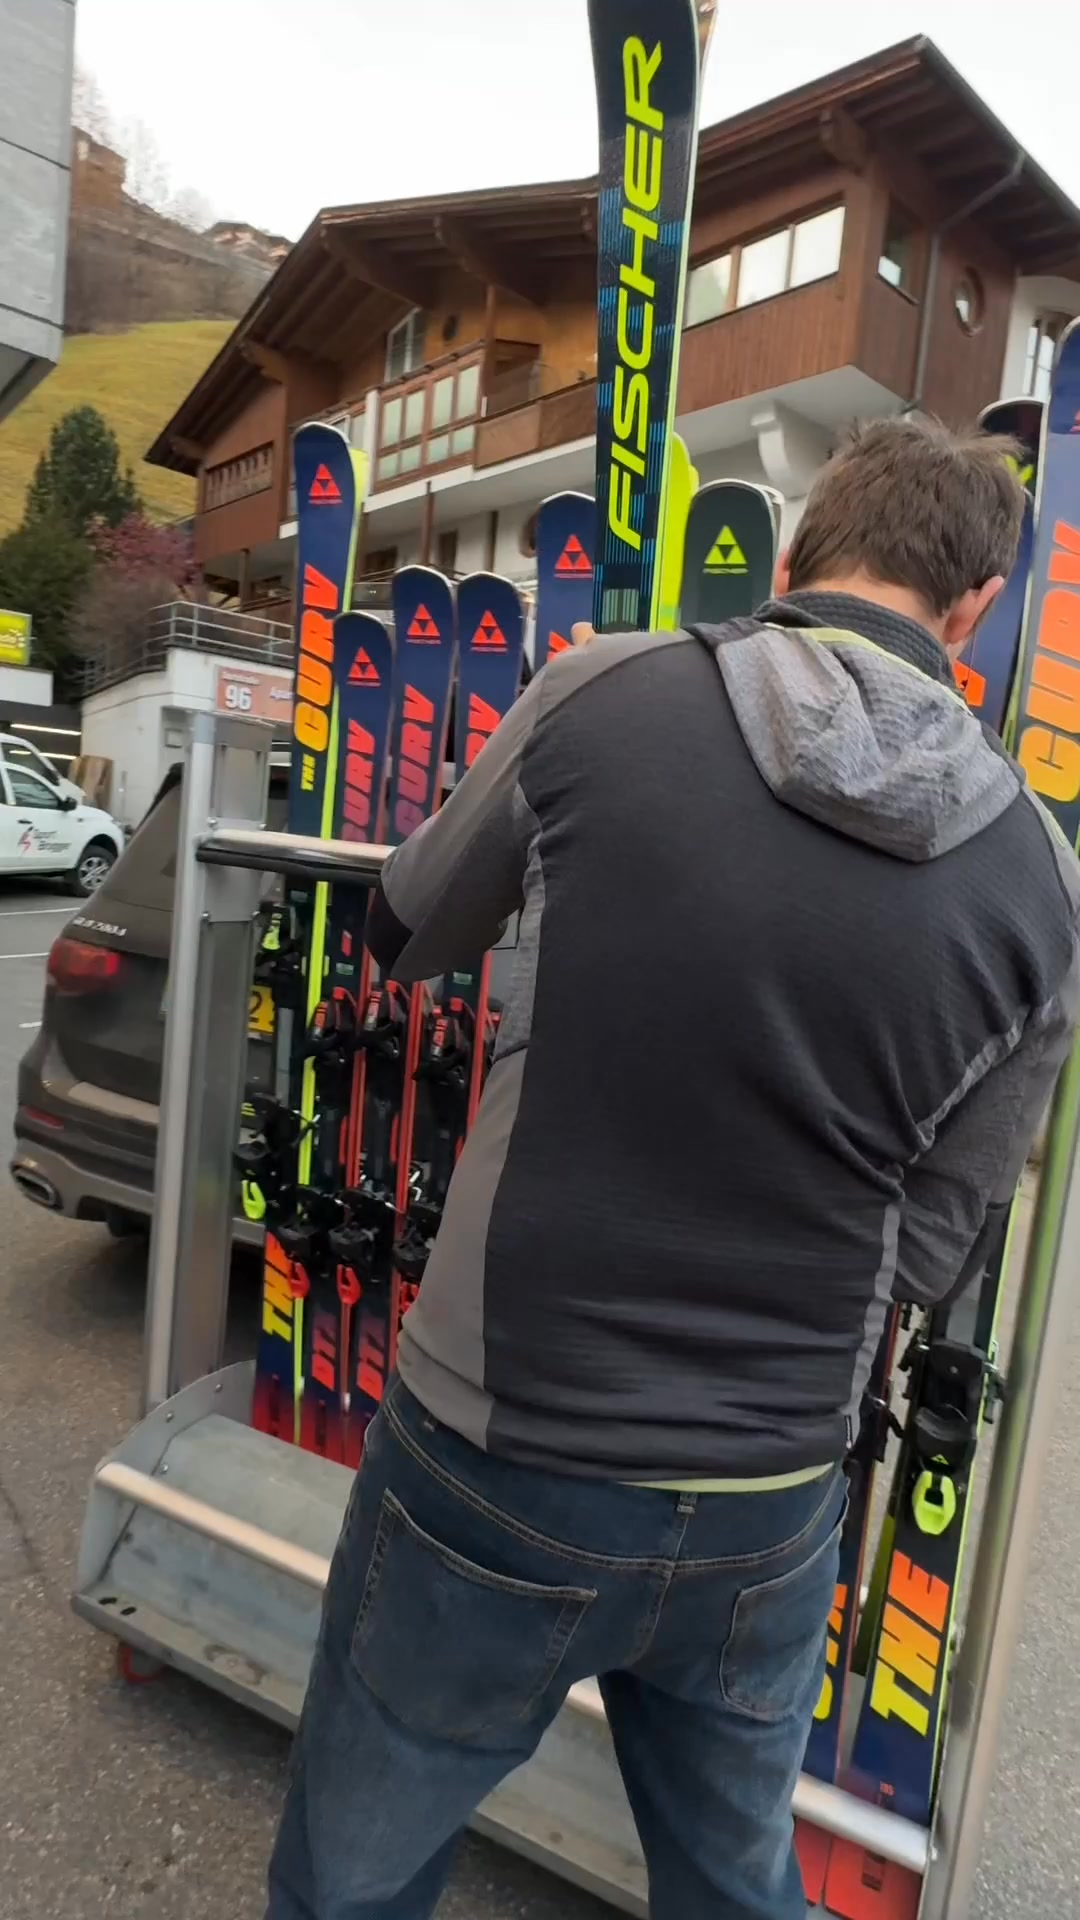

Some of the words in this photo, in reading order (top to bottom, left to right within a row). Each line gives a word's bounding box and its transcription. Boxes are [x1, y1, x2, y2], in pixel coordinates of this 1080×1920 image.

[608, 35, 663, 551] FISCHER
[225, 684, 252, 711] 96
[294, 564, 339, 752] CURV
[300, 754, 316, 791] THE
[395, 683, 435, 837] CURV
[869, 1548, 950, 1738] THE
